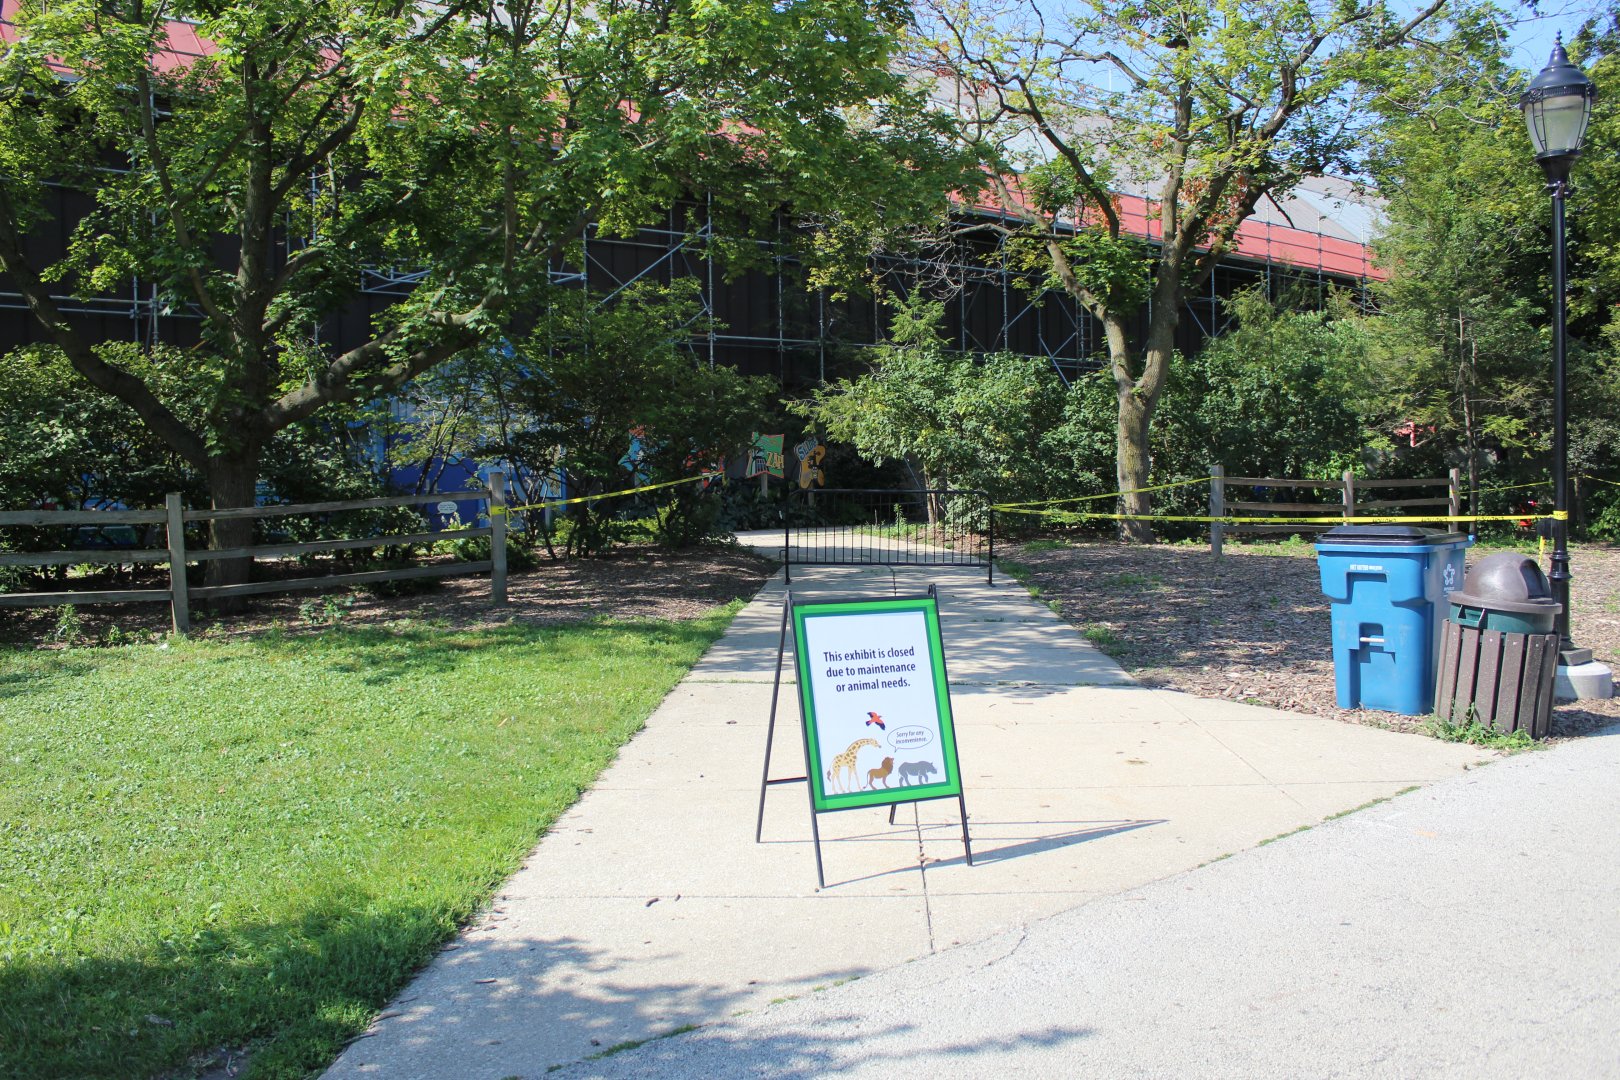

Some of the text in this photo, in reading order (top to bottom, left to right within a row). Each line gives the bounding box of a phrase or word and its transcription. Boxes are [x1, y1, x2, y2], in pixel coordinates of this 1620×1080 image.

[823, 646, 915, 662] This exhibit is closed
[826, 664, 916, 677] due to maintenance
[836, 677, 911, 692] or animal needs.
